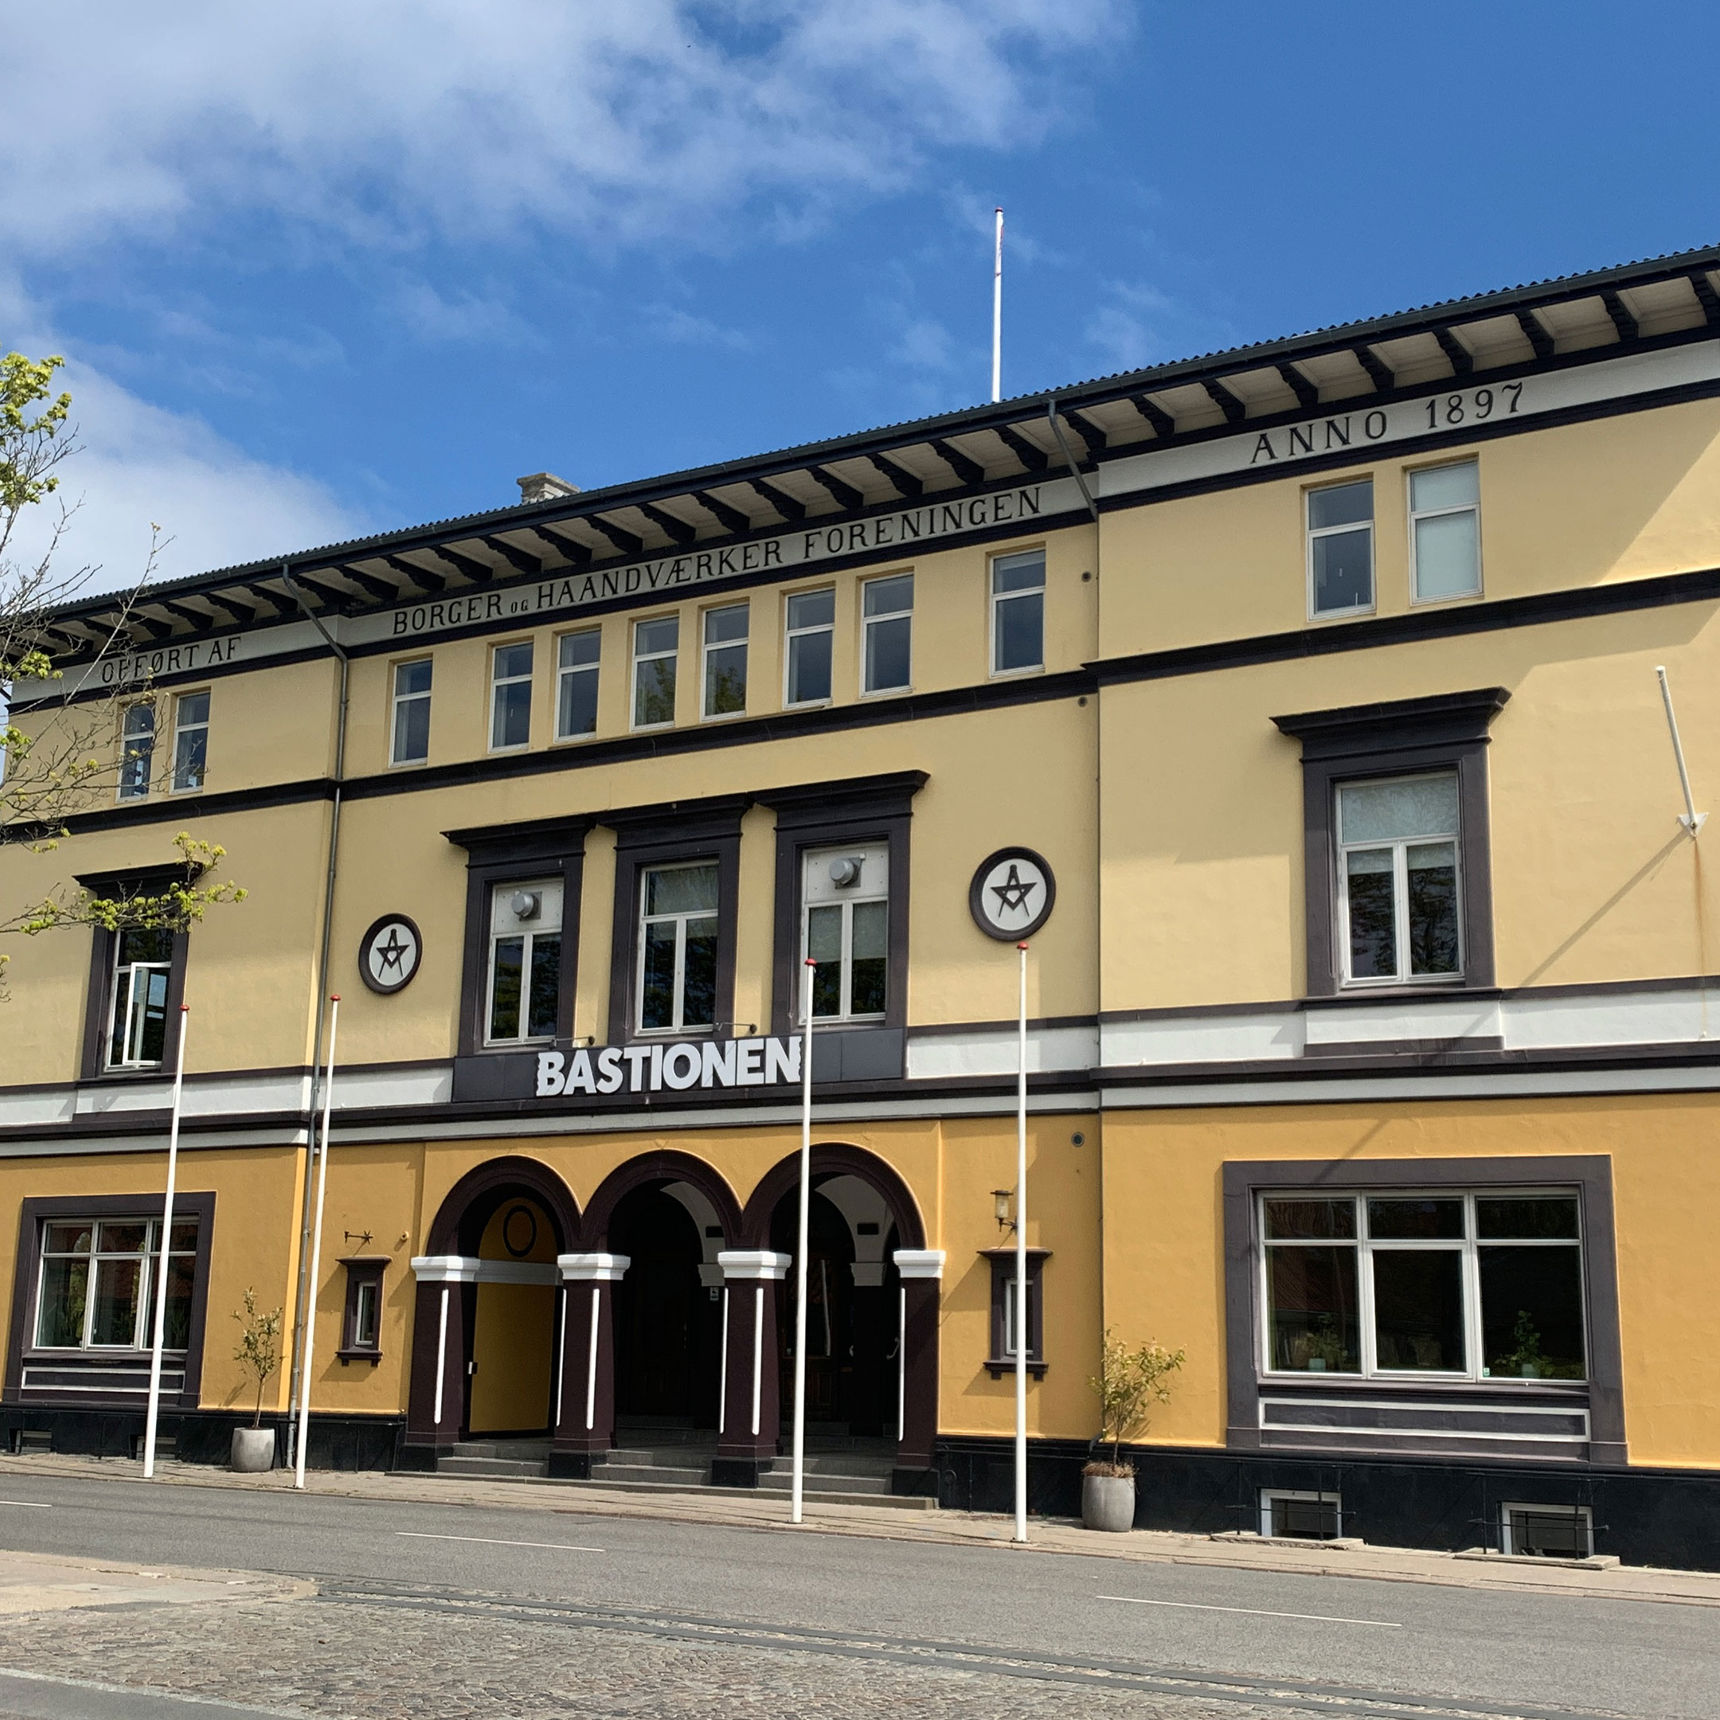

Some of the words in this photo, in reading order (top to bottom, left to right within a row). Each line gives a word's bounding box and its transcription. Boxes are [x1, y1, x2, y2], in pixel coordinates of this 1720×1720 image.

[1250, 410, 1387, 464] ANNO
[1425, 381, 1523, 429] 1897
[392, 593, 503, 635] BORGER
[510, 600, 528, 614] OG
[536, 540, 783, 609] HAANDVÆRKER
[803, 487, 1041, 559] FORENINGEN
[102, 644, 200, 683] OPFØRT
[208, 637, 241, 664] AF
[536, 1035, 802, 1097] BASTIONEN
